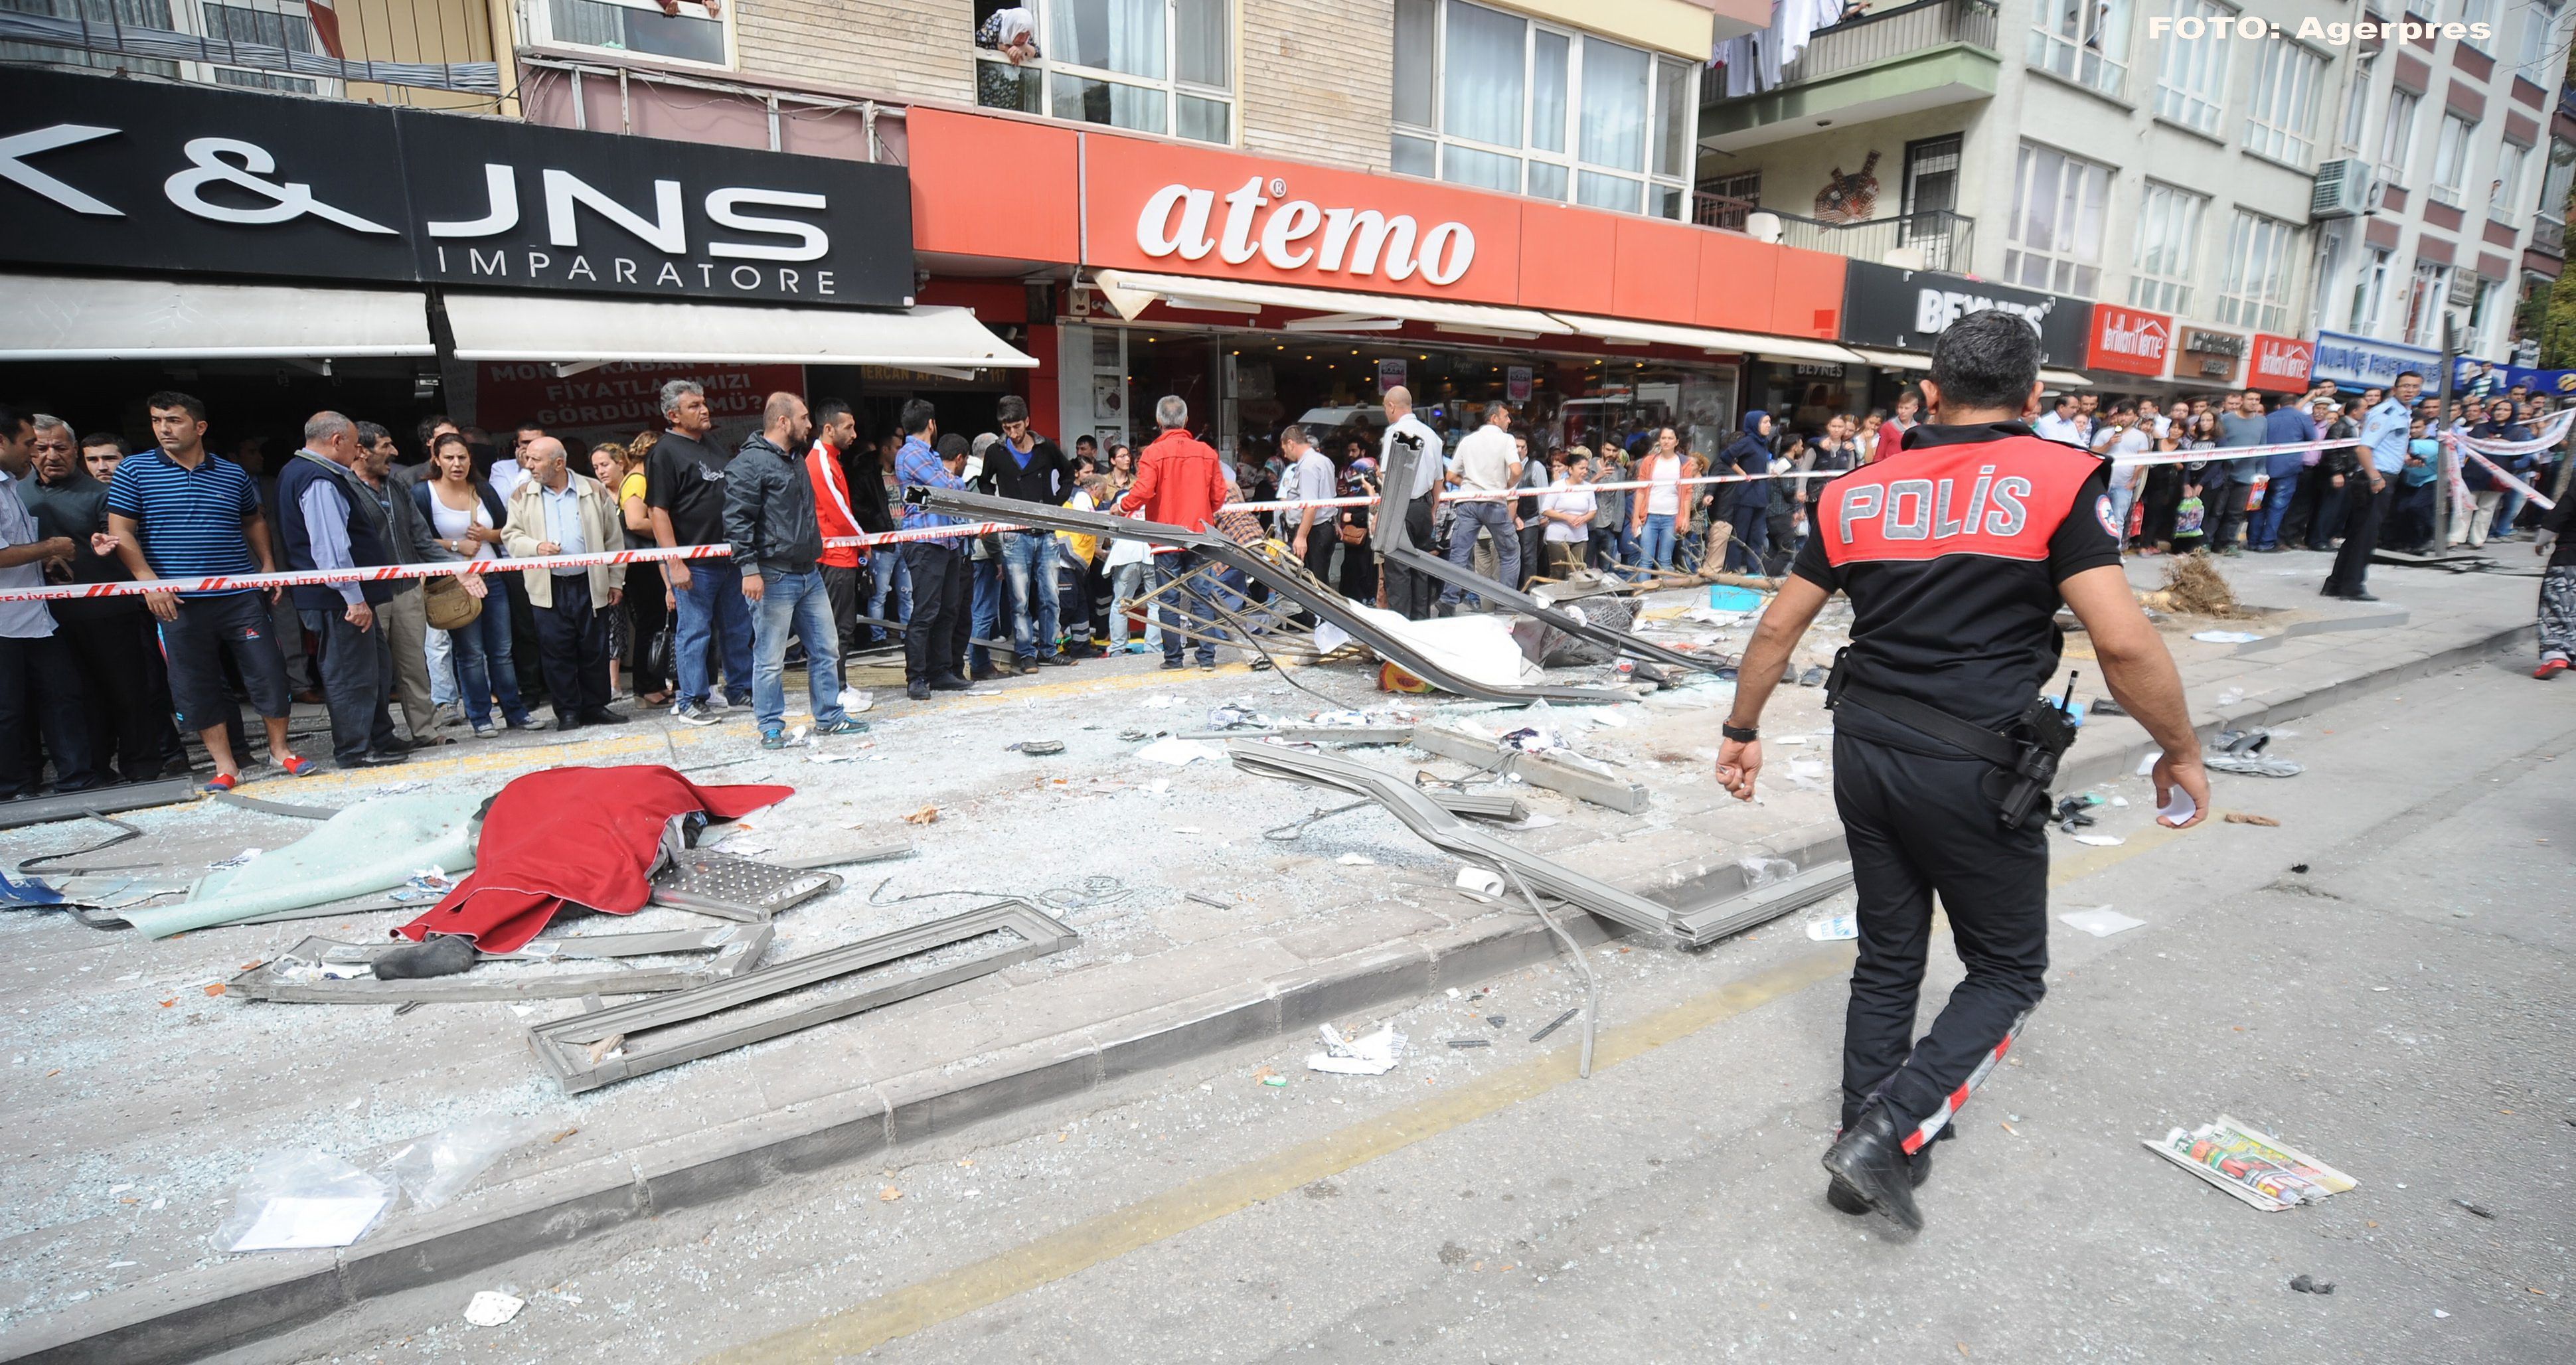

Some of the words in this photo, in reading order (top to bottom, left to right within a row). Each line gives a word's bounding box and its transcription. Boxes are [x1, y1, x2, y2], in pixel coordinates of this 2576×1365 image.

[428, 163, 829, 262] JNS
[1136, 176, 1476, 286] atemo
[437, 245, 836, 295] IMPARATORE
[1915, 288, 2045, 341] BES
[490, 363, 561, 382] MON
[546, 373, 751, 401] FİYATLAMIZI
[537, 399, 662, 426] GÖRDÜN
[1840, 465, 2032, 544] POLİS
